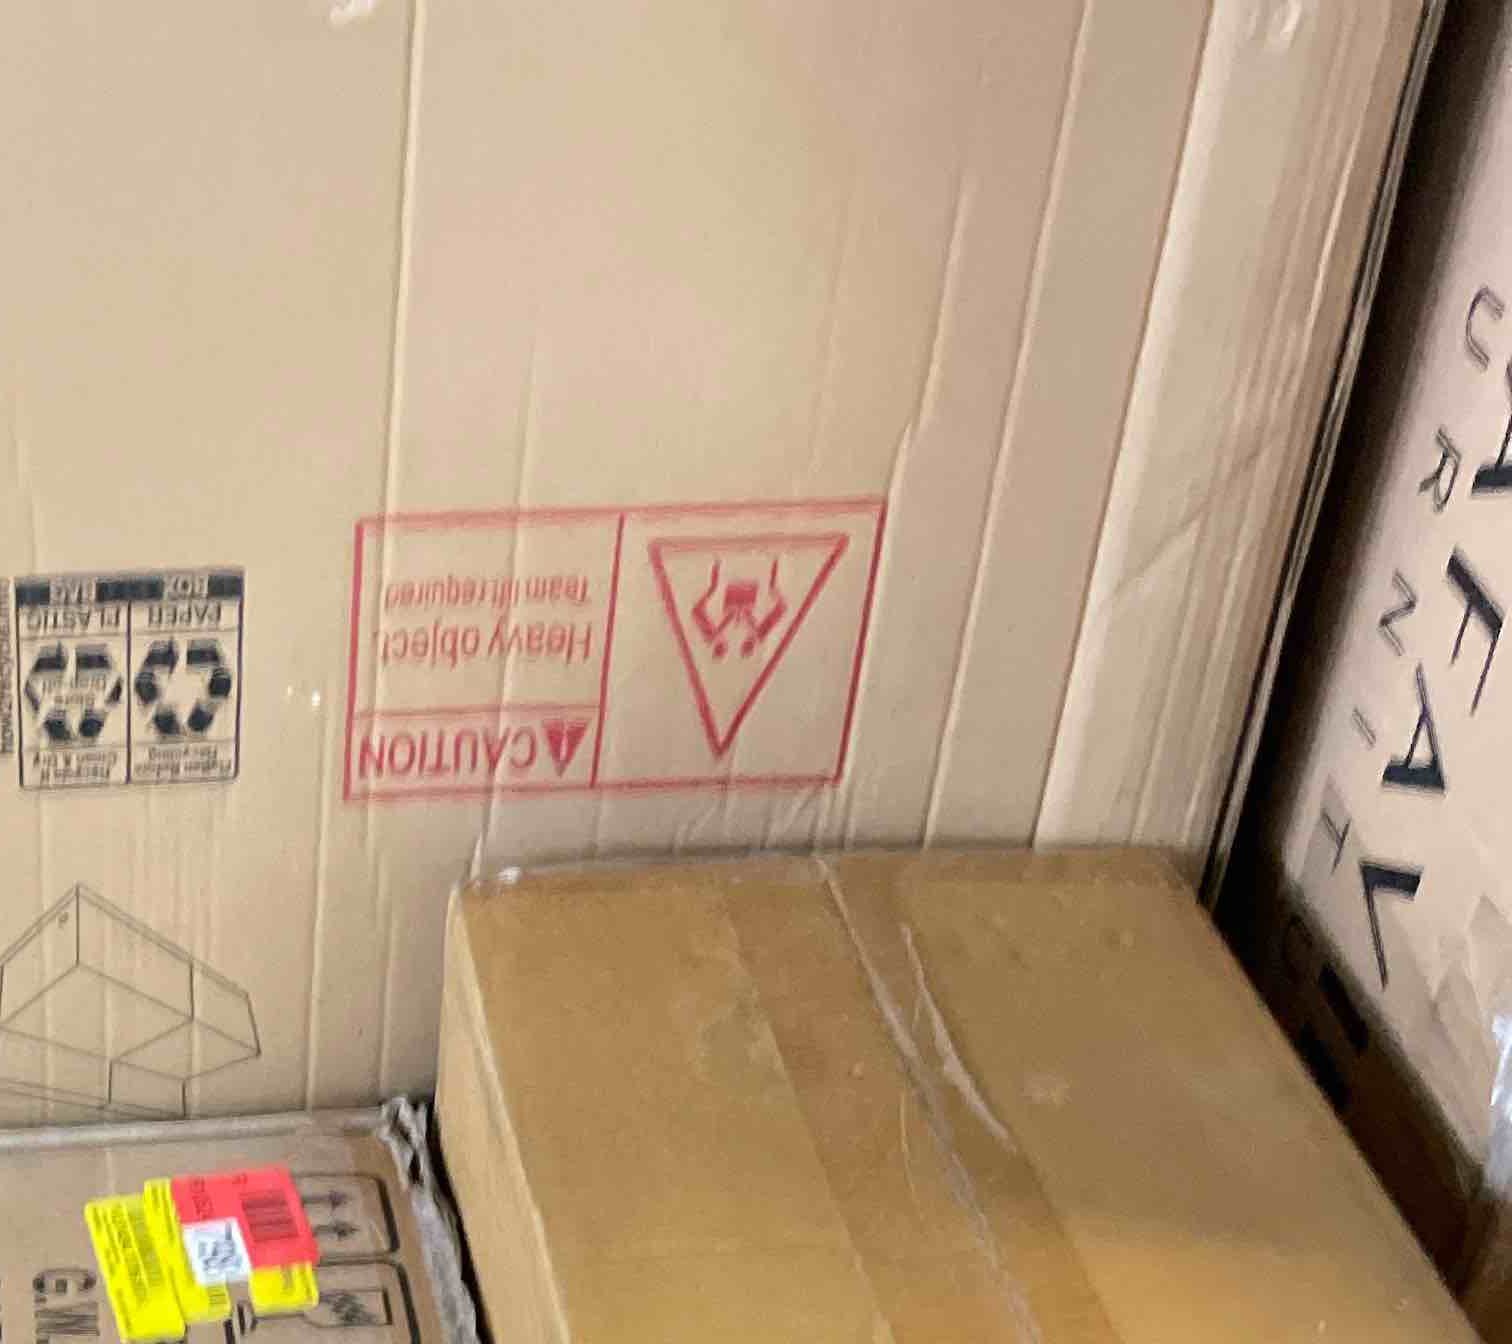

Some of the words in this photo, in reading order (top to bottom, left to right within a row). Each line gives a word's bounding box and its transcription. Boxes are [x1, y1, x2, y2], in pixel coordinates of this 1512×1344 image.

[525, 575, 589, 607] Team
[26, 605, 120, 630] PLASTIC
[148, 604, 222, 627] PAPER
[488, 616, 593, 664] Heavy
[359, 726, 538, 778] CAUTION
